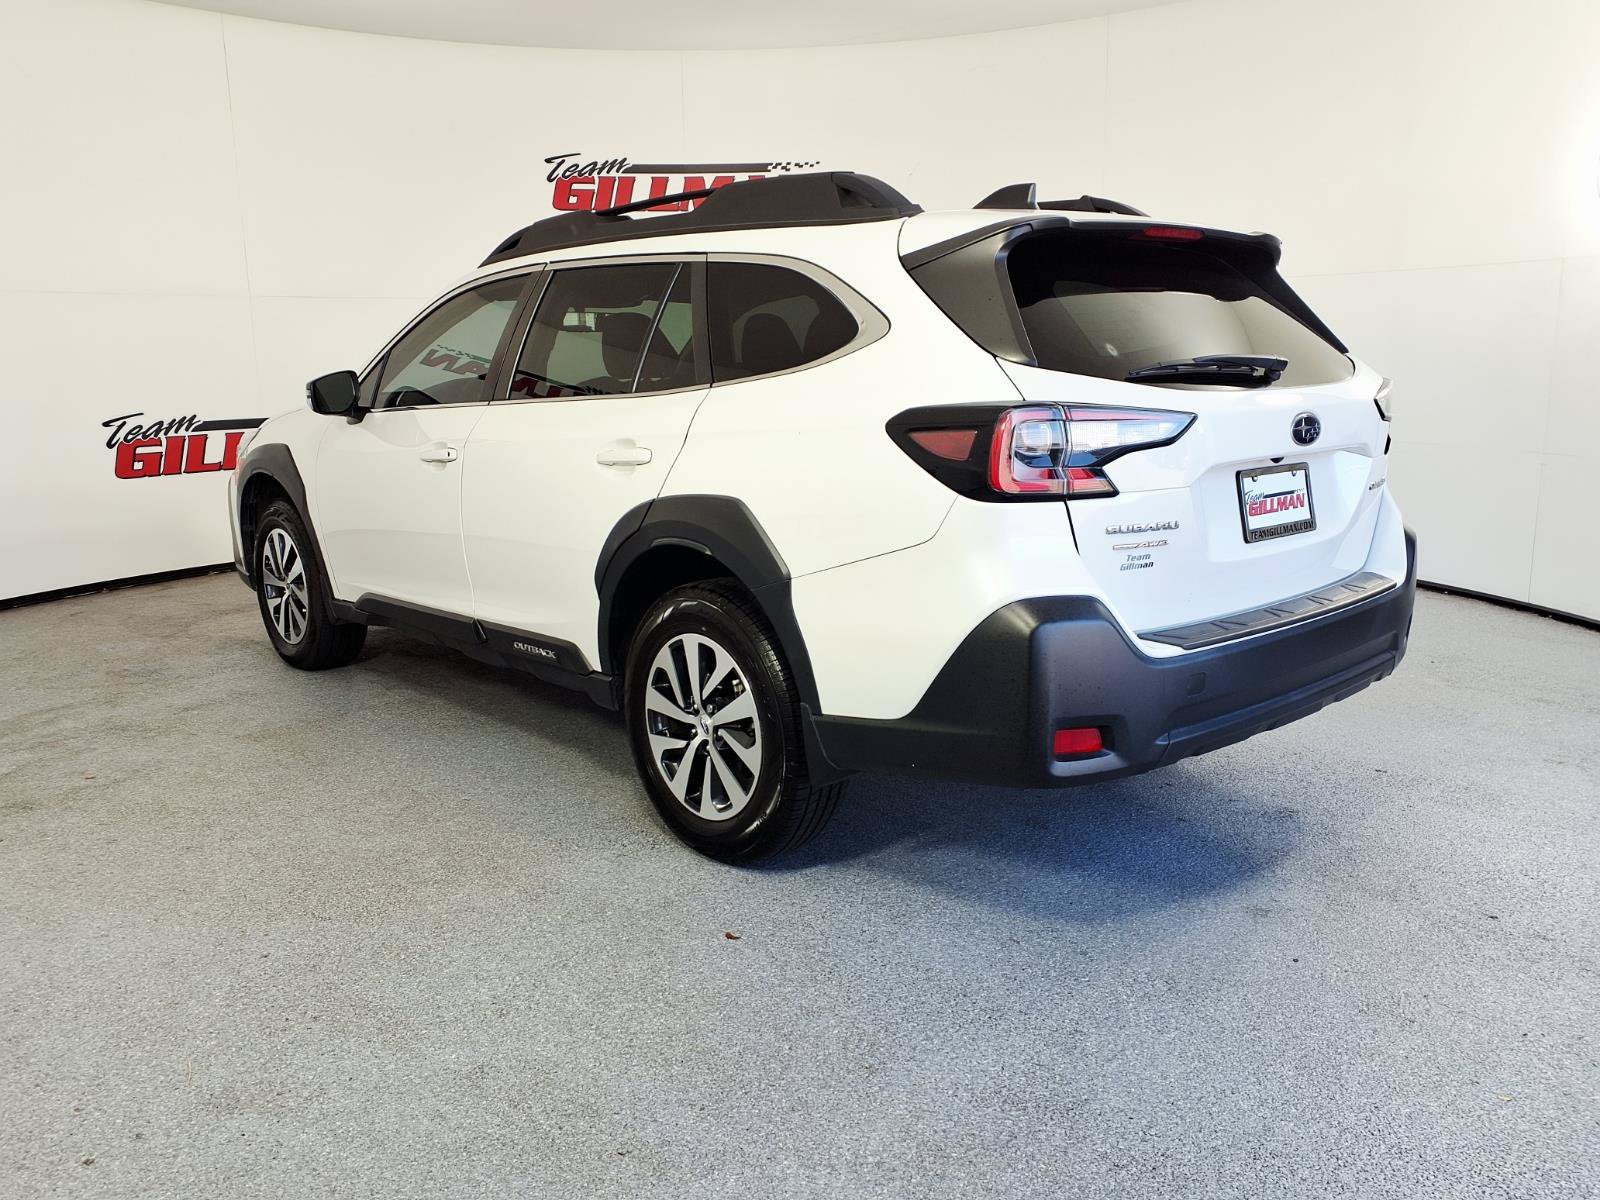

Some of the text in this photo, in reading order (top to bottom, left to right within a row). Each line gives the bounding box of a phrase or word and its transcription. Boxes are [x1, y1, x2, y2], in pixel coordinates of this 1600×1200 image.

[544, 152, 630, 183] Team
[552, 174, 766, 212] GILLM
[102, 412, 202, 449] Team
[1248, 493, 1306, 517] GILLMAN
[1105, 520, 1180, 535] SUBARU
[1250, 520, 1315, 541] TEAMGILLMAN.COM
[1119, 561, 1154, 572] Gillman
[1126, 553, 1151, 562] Team
[513, 641, 557, 659] OUTBACK
